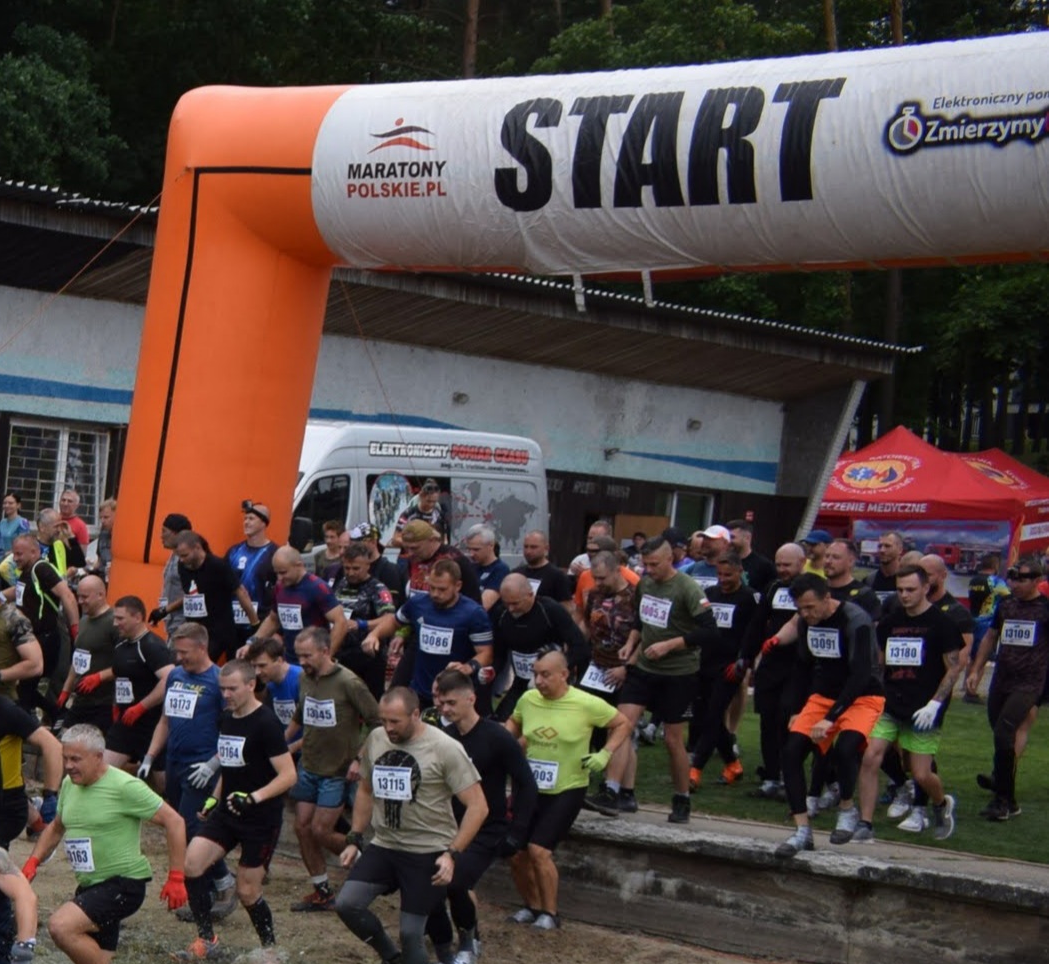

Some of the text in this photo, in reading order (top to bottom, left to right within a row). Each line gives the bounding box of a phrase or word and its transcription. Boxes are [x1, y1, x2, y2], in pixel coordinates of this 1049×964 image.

[932, 93, 1023, 110] Elektroniczny
[924, 117, 1045, 143] Zmierzymy
[494, 77, 847, 212] START
[347, 161, 447, 179] MARATONY
[347, 181, 447, 198] POLSKIE.PL
[369, 441, 449, 458] ELEKTRONICZNY
[820, 501, 927, 513] ECZENIE MEDYCZNE
[422, 634, 449, 648] 13086
[1005, 628, 1031, 640] 13109
[810, 638, 835, 650] 13091
[890, 647, 917, 659] 13180
[170, 698, 191, 711] 13173
[532, 769, 554, 782] 003
[377, 777, 405, 791] 13115
